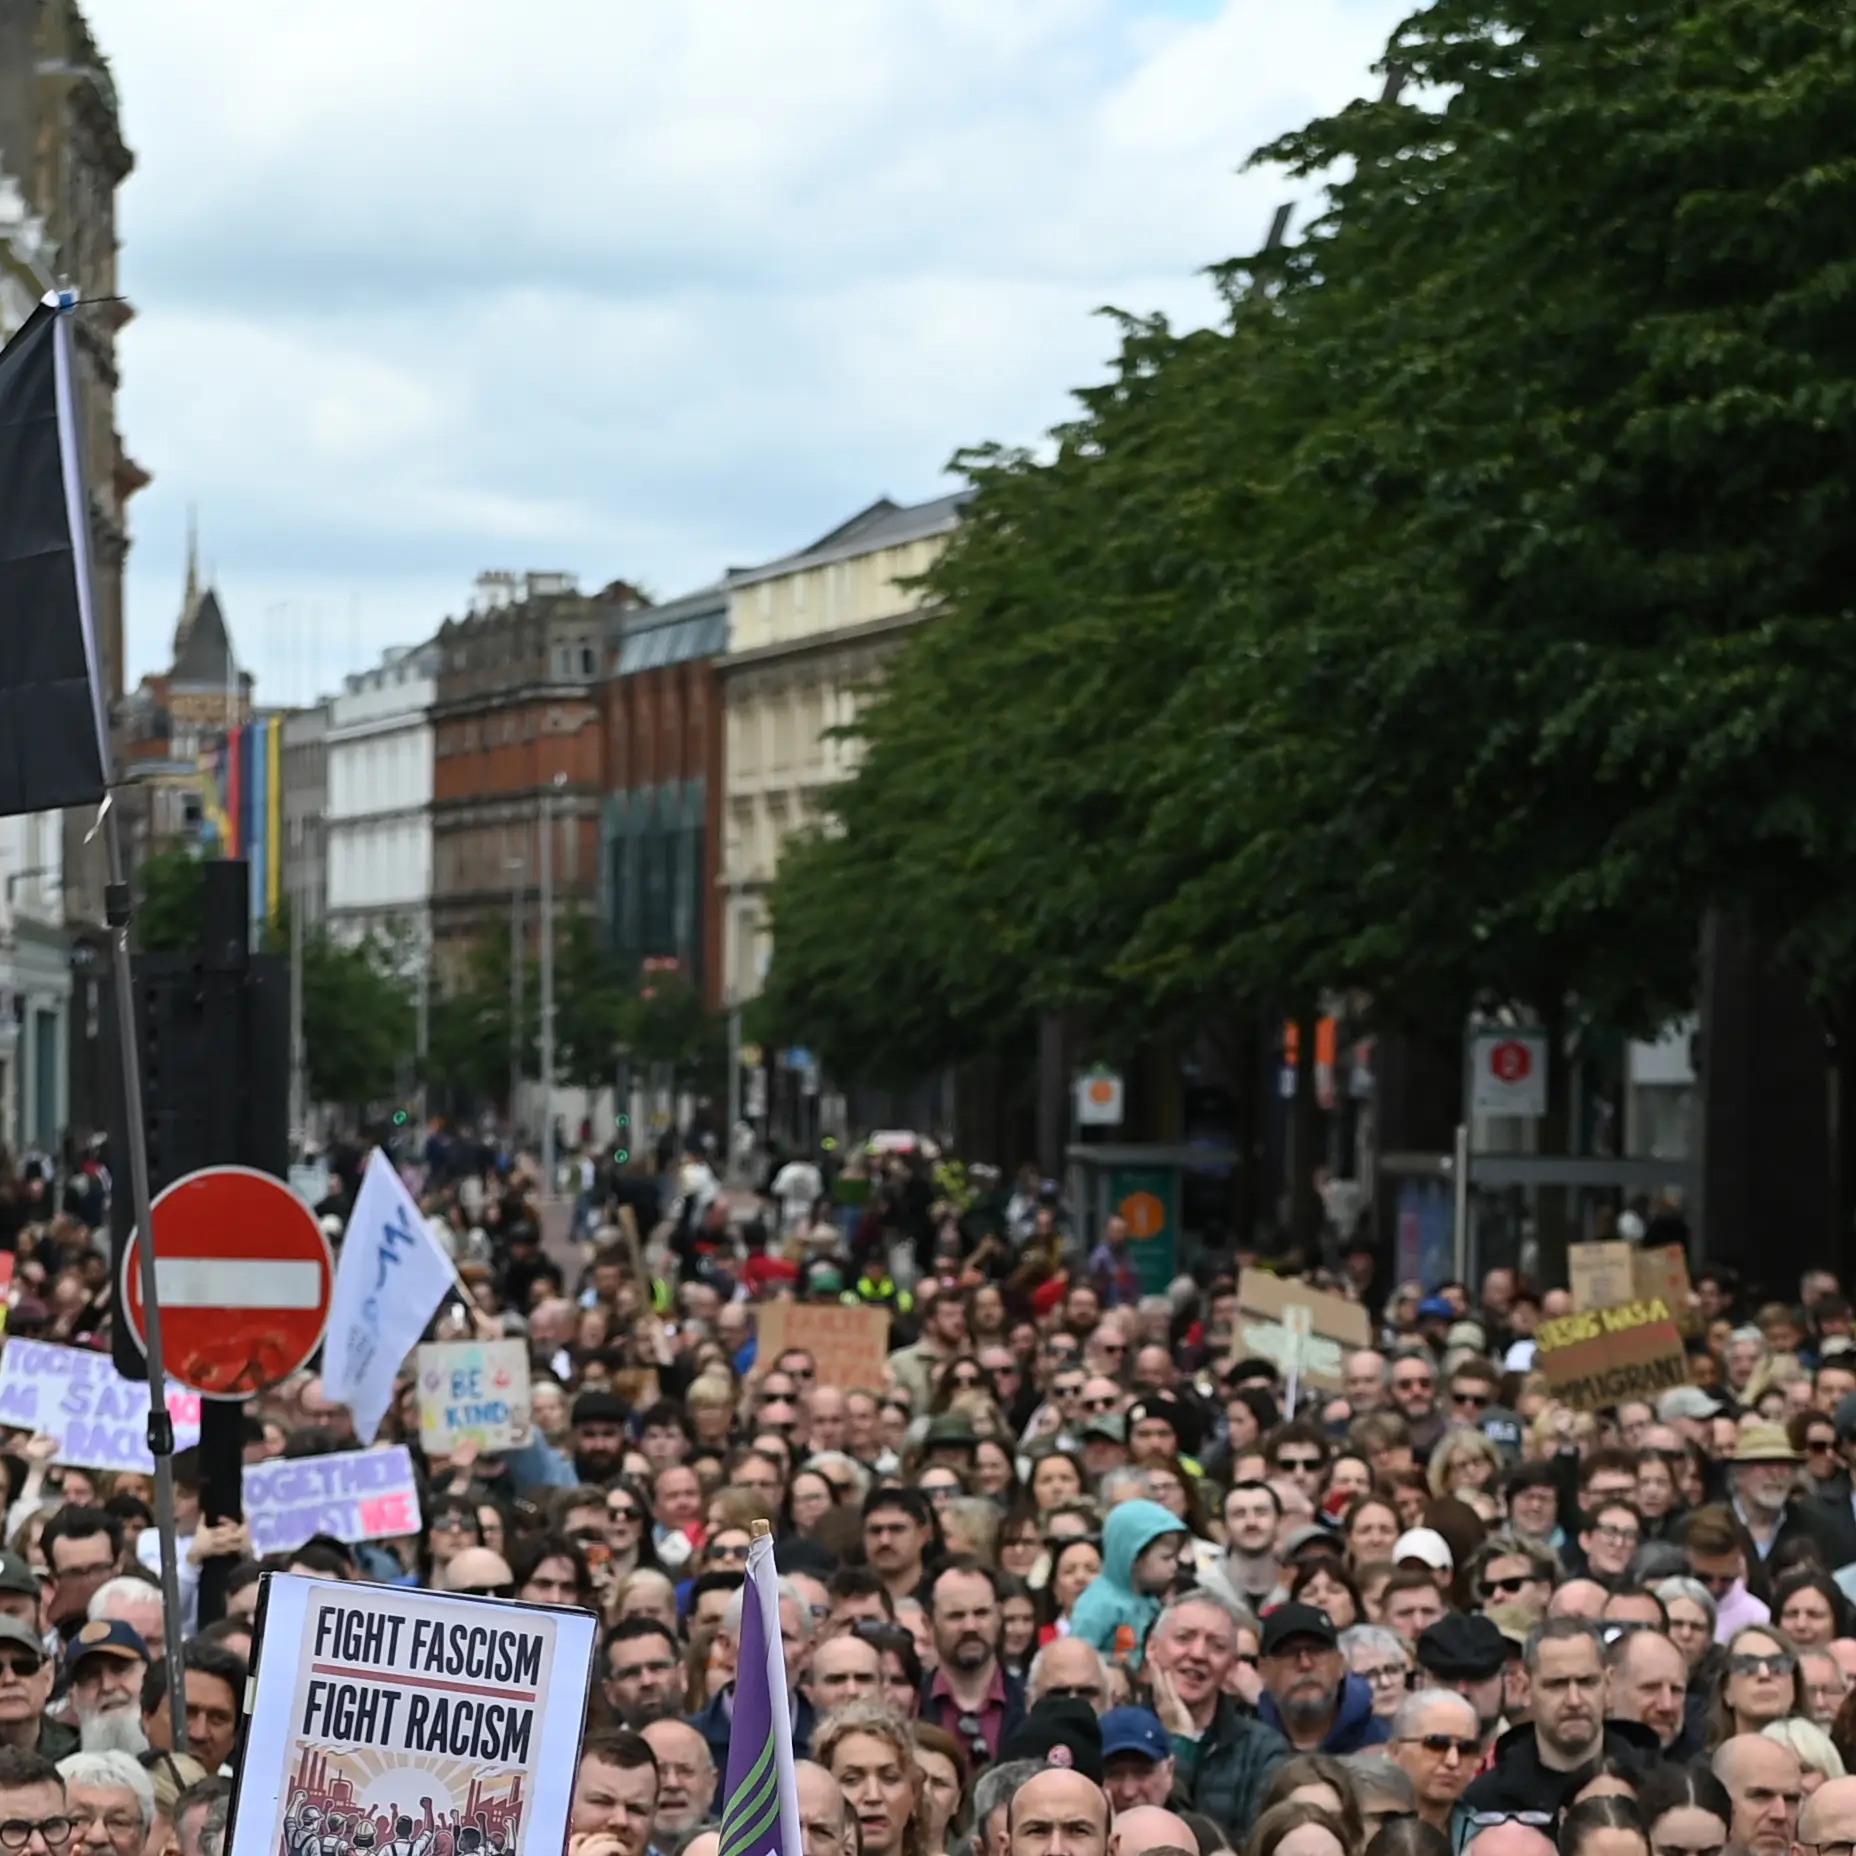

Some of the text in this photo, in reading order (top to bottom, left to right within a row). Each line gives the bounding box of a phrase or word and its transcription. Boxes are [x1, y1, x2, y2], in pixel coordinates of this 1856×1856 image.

[450, 1368, 484, 1401] BE
[445, 1400, 510, 1429] KIND
[243, 1450, 408, 1498] OGETHER
[314, 1605, 544, 1687] FIGHT FASCISM
[301, 1680, 534, 1765] FIGHT RACISM
